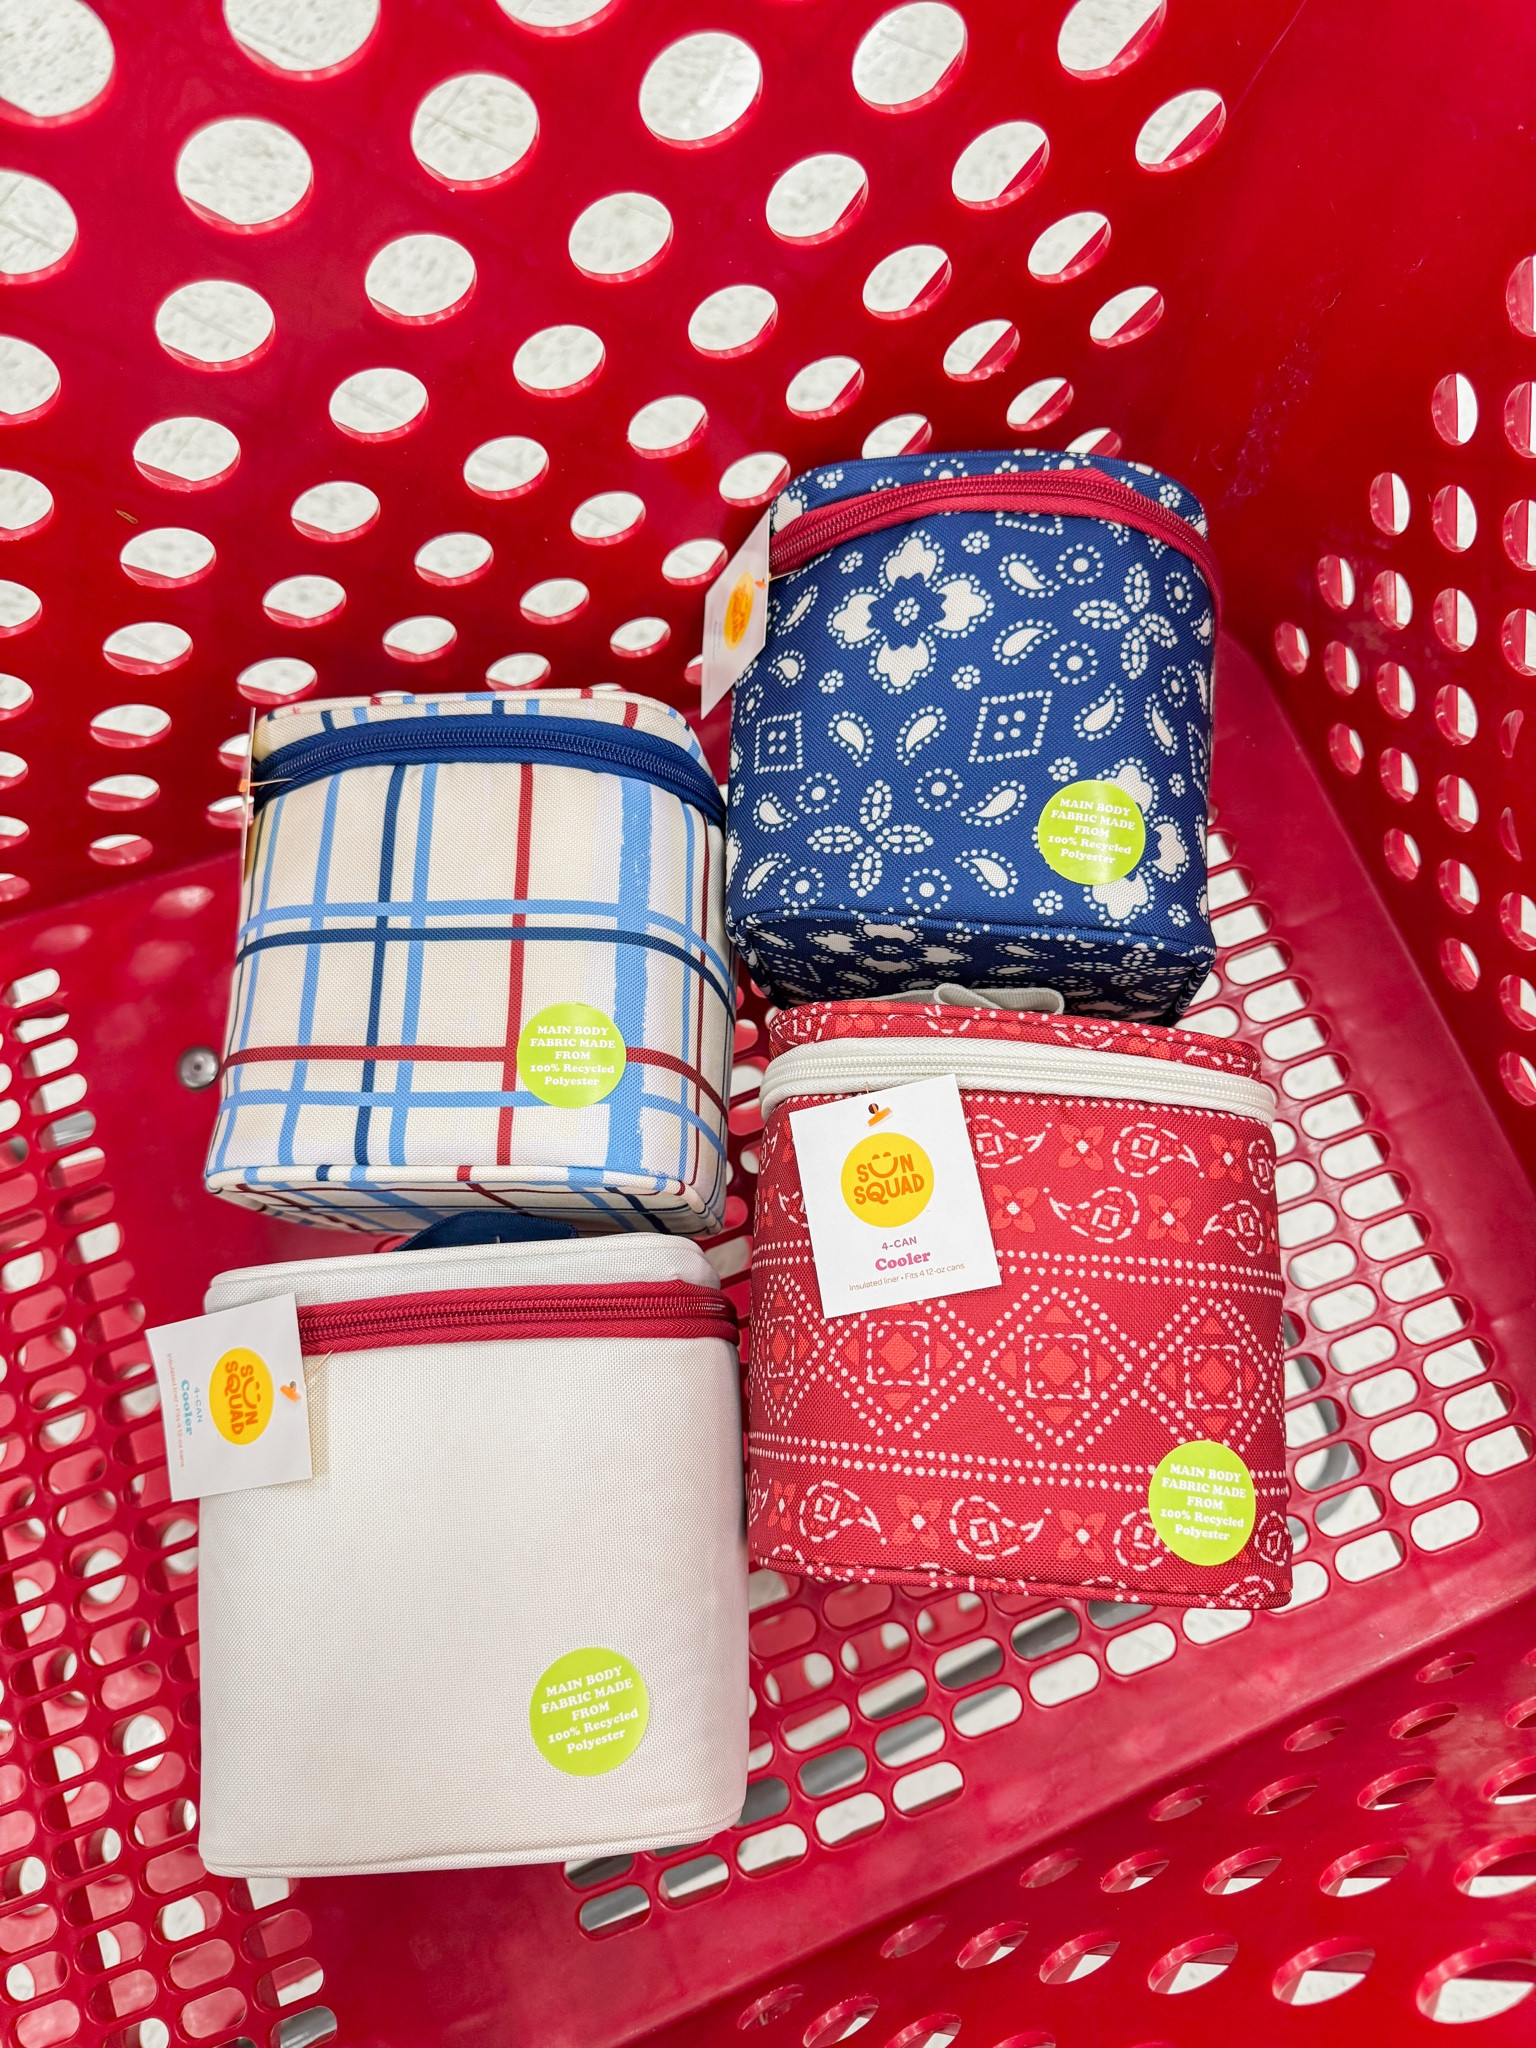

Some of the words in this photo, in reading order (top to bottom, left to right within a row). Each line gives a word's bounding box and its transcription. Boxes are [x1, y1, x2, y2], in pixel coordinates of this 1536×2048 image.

[1060, 798, 1094, 810] MAIN
[1096, 802, 1130, 816] BODY
[1050, 810, 1097, 823] FABRIC
[1100, 816, 1136, 830] MADE
[1074, 826, 1110, 838] FROM
[1048, 836, 1077, 845] 100%
[1081, 838, 1131, 854] Recycled
[1061, 848, 1116, 864] Polyester
[538, 1026, 570, 1035] MAIN
[574, 1026, 609, 1036] BODY
[530, 1038, 576, 1047] FABRIC
[579, 1039, 616, 1049] MADE
[555, 1051, 591, 1060] FROM
[530, 1064, 560, 1072] 100%
[563, 1064, 615, 1074] Recycled
[545, 1076, 600, 1087] Polyester
[856, 1152, 914, 1182] SUN
[854, 1174, 924, 1205] SQUAD
[882, 1236, 917, 1250] 4-CAN
[875, 1251, 931, 1271] Cooler
[849, 1280, 882, 1291] Insulated
[884, 1276, 899, 1284] liner
[905, 1272, 918, 1280] Fits
[926, 1267, 945, 1276] 12-oz
[947, 1263, 965, 1271] cans
[194, 1387, 203, 1423] 4-CAN
[224, 1360, 244, 1435] SQUAD
[240, 1364, 260, 1426] SUN
[181, 1379, 192, 1436] Cooler
[1170, 1464, 1205, 1478] MAIN
[1208, 1469, 1242, 1483] BODY
[1162, 1477, 1210, 1493] FABRIC
[1213, 1484, 1246, 1498] MADE
[1187, 1496, 1223, 1510] FROM
[1160, 1509, 1191, 1520] 100%
[1194, 1512, 1244, 1528] Recycled
[1175, 1524, 1230, 1541] Polyester
[546, 1678, 583, 1697] MAIN
[586, 1665, 622, 1686] BODY
[541, 1692, 591, 1714] FABRIC
[594, 1678, 633, 1698] MADE
[571, 1701, 610, 1721] FROM
[548, 1726, 580, 1744] 100%
[584, 1708, 639, 1733] Recycled
[566, 1729, 626, 1754] Polyester
